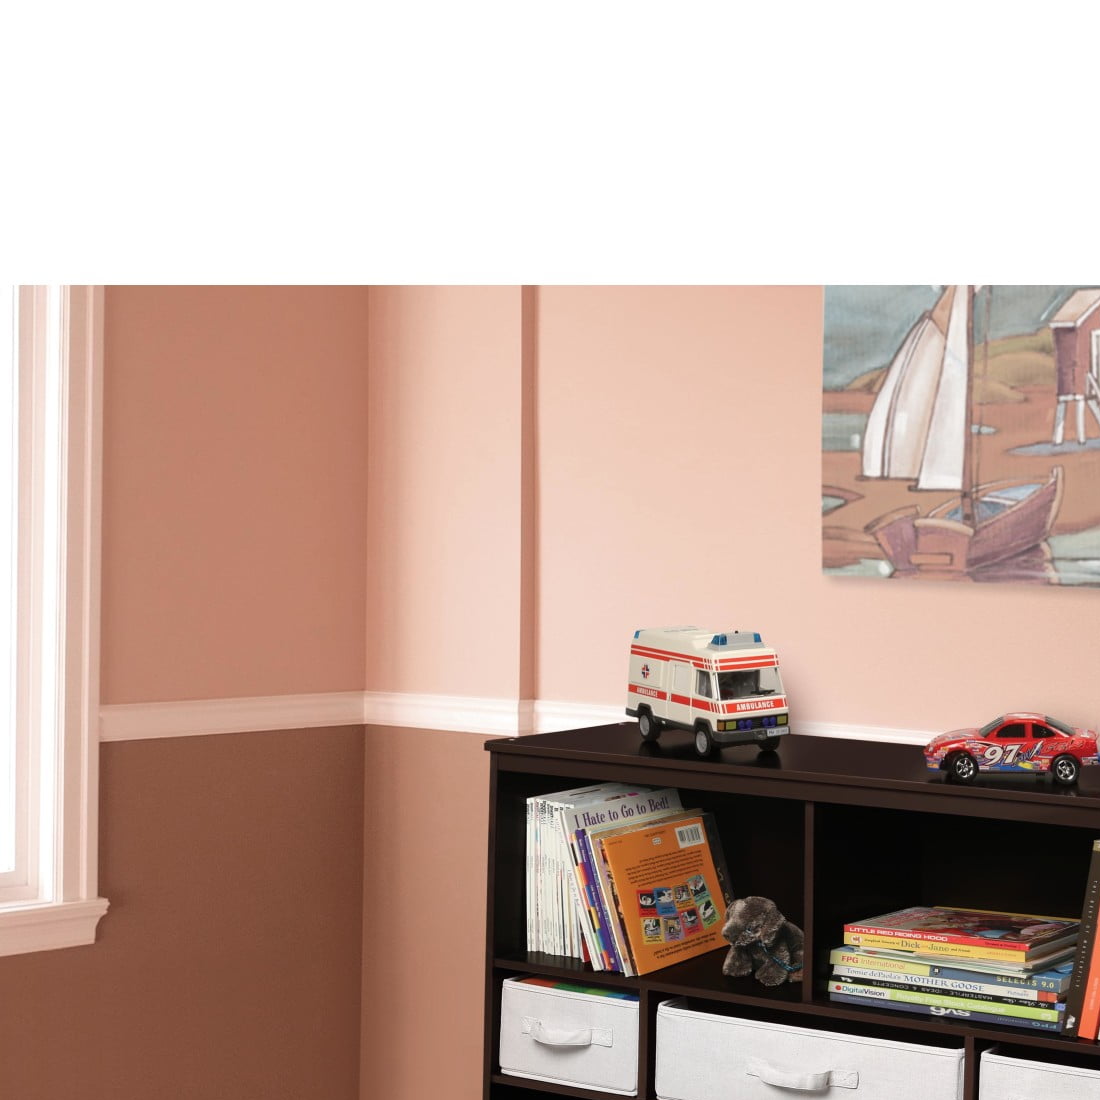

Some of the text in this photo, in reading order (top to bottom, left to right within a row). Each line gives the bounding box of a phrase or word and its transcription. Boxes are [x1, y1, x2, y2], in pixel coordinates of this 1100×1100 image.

[736, 700, 775, 711] AMBULANCE
[984, 744, 1020, 766] 97
[574, 814, 580, 829] I
[582, 811, 606, 828] Hate
[608, 808, 619, 821] to
[621, 805, 634, 819] Go
[636, 802, 647, 815] to
[649, 797, 669, 812] Bed!
[894, 931, 921, 939] RIDING
[900, 940, 920, 949] Dick
[841, 955, 906, 970] FPG International
[872, 981, 909, 989] CONCEPTS
[904, 975, 949, 987] MOTHER
[951, 982, 985, 992] GOOSE
[842, 985, 885, 997] DigitalVision
[949, 991, 993, 1000] MASTERFILE
